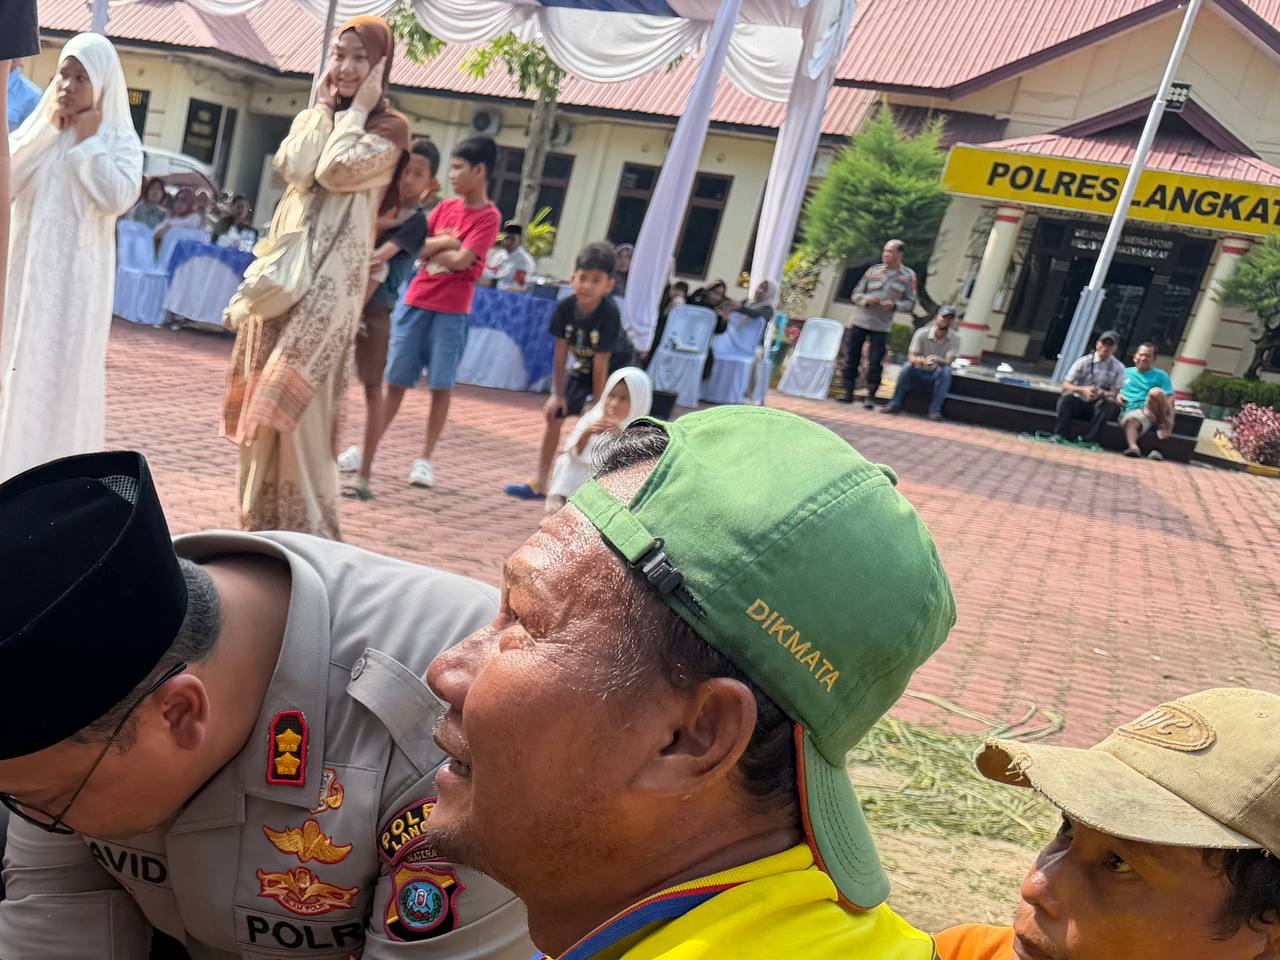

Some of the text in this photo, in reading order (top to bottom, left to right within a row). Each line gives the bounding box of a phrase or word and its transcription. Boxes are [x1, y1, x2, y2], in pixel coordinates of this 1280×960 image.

[987, 162, 1280, 226] POLRES ANGKA
[745, 598, 840, 692] DIKMATA
